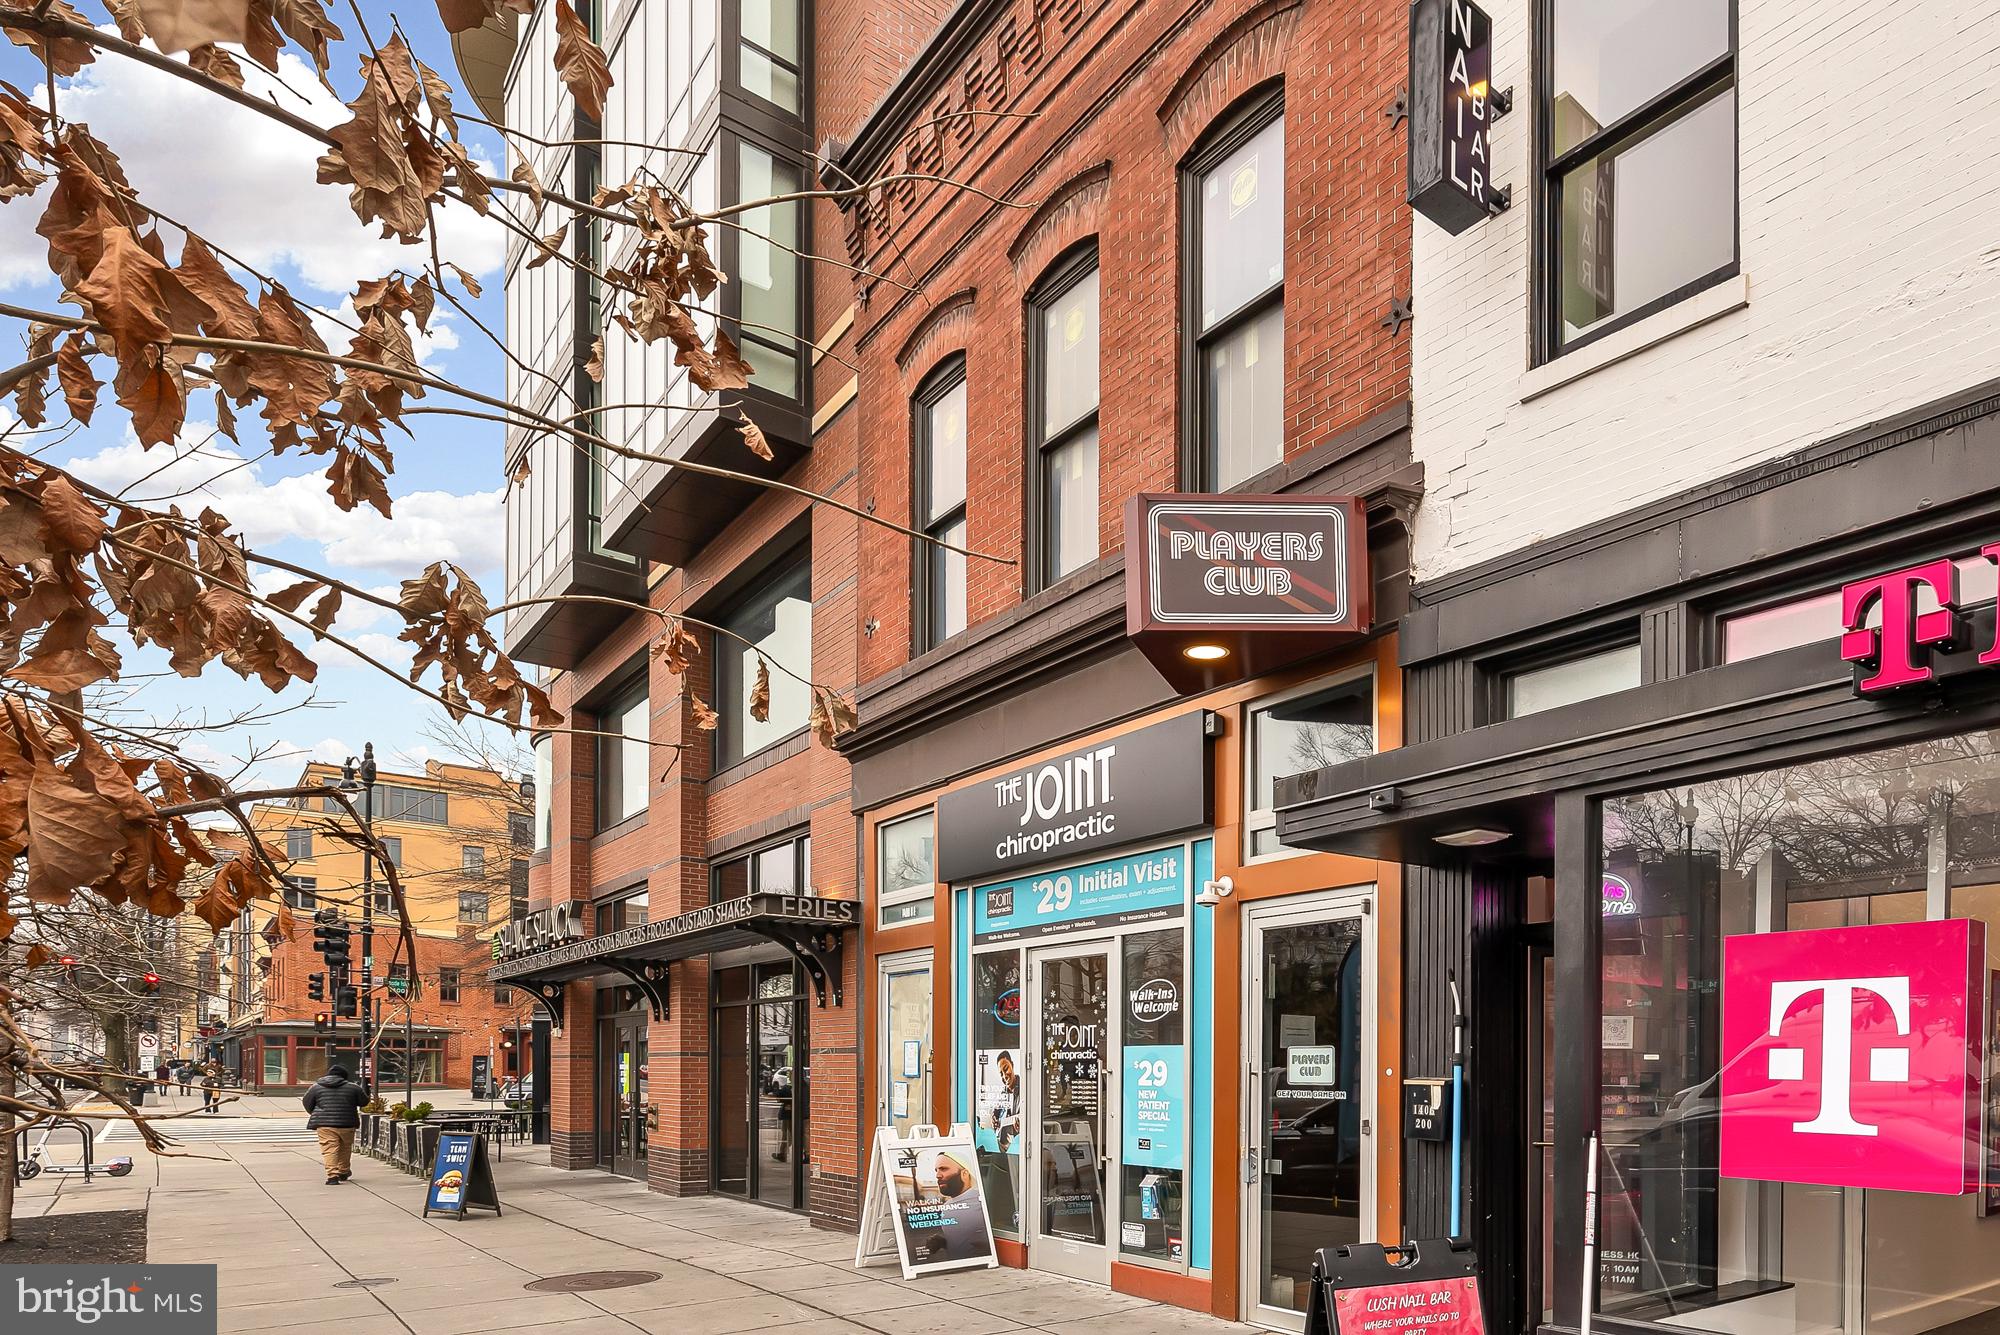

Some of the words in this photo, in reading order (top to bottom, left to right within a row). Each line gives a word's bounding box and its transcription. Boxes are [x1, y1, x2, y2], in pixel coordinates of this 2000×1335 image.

[1449, 0, 1473, 191] NAIL
[1470, 87, 1485, 204] BAR
[1170, 530, 1324, 562] PLAYERS
[1203, 566, 1292, 596] CLUB
[994, 775, 1022, 808] THE
[995, 811, 1115, 859] chiropractic
[1032, 875, 1073, 914] $29
[1079, 865, 1128, 894] Initial
[1133, 857, 1177, 884] Visit
[781, 896, 853, 920] FRIES
[500, 917, 532, 957] SHAKE
[533, 900, 578, 947] SHACK
[598, 935, 615, 952] SODA
[615, 926, 646, 949] BURGERS
[646, 917, 676, 941] FROZEN
[676, 907, 714, 934] CUSTARD
[715, 897, 753, 924] SHAKES
[1130, 988, 1173, 1001] Walk-Ins
[1134, 1001, 1179, 1013] Welcome
[1051, 1023, 1065, 1035] THE
[1050, 1049, 1097, 1061] chiropractic
[1291, 1054, 1330, 1065] PLAYERS
[1133, 1060, 1168, 1087] $29
[1299, 1066, 1322, 1077] CLUB
[1138, 1090, 1157, 1099] NEW
[1276, 1090, 1291, 1098] GET
[1291, 1090, 1312, 1099] YOUR
[1312, 1090, 1334, 1099] GAME
[1335, 1091, 1347, 1099] ON
[1138, 1101, 1170, 1110] PATIENT
[1138, 1111, 1170, 1121] SPECIAL
[1415, 1118, 1432, 1129] 200
[450, 1145, 468, 1154] TEAM
[906, 1198, 943, 1207] WALK-IN.
[921, 1202, 970, 1213] INSURANCE.
[908, 1213, 939, 1222] NIGHTS
[910, 1218, 958, 1229] WEEKENDS.
[1613, 1265, 1640, 1273] 10AM
[1611, 1276, 1635, 1284] 11AM
[1367, 1296, 1397, 1312] LUSH
[1399, 1293, 1427, 1309] NAIL
[1431, 1290, 1451, 1305] BAR
[1364, 1320, 1393, 1330] WHERE
[1394, 1317, 1414, 1327] YOUR
[1415, 1313, 1437, 1324] NAILS
[1439, 1312, 1450, 1321] GO
[1450, 1311, 1460, 1320] TO
